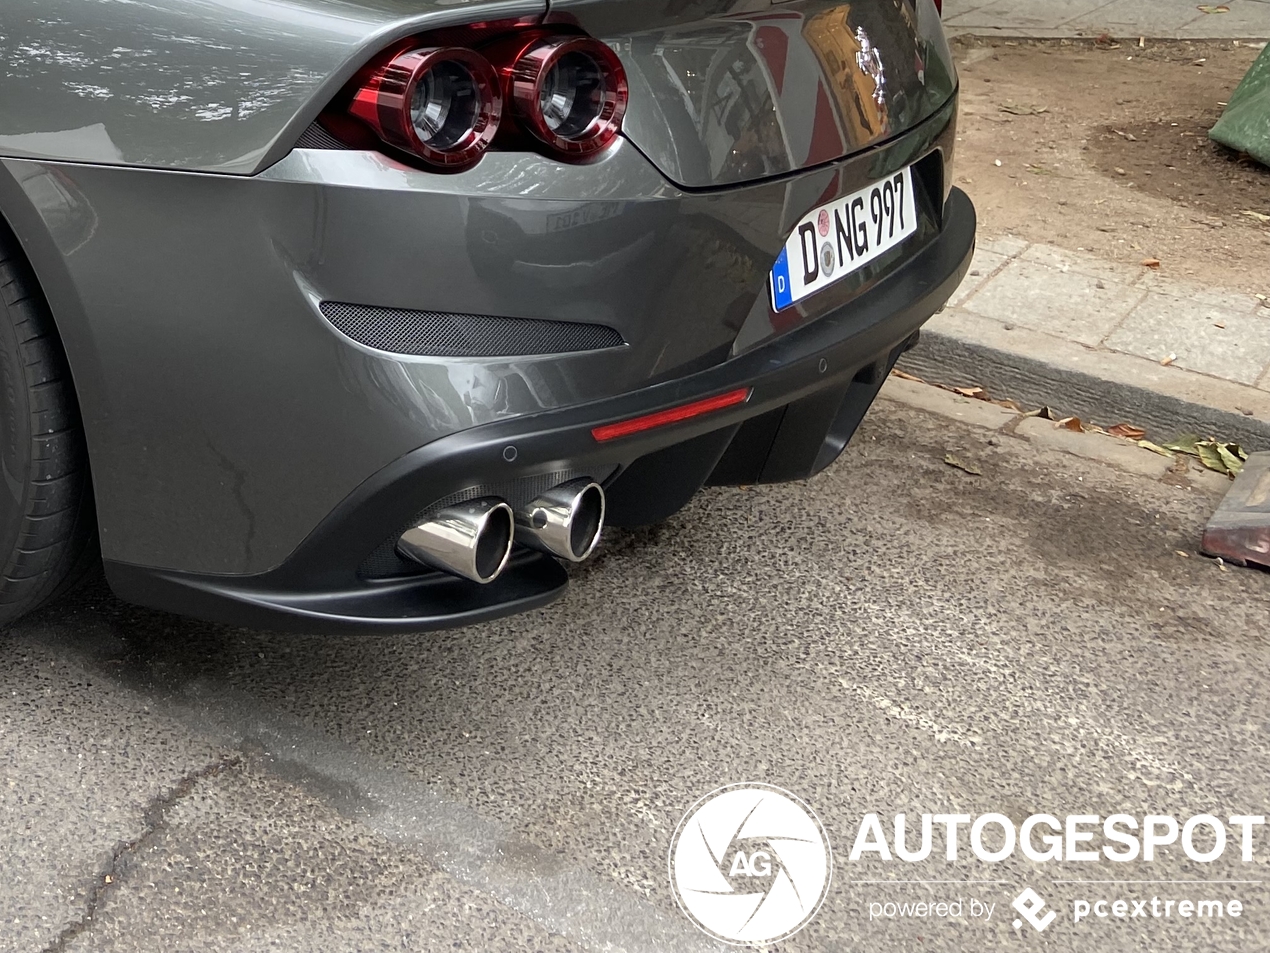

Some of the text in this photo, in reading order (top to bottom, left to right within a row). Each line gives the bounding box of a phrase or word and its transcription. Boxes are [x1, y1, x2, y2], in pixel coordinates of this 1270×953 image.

[798, 171, 905, 286] D NG 997
[777, 274, 786, 294] D
